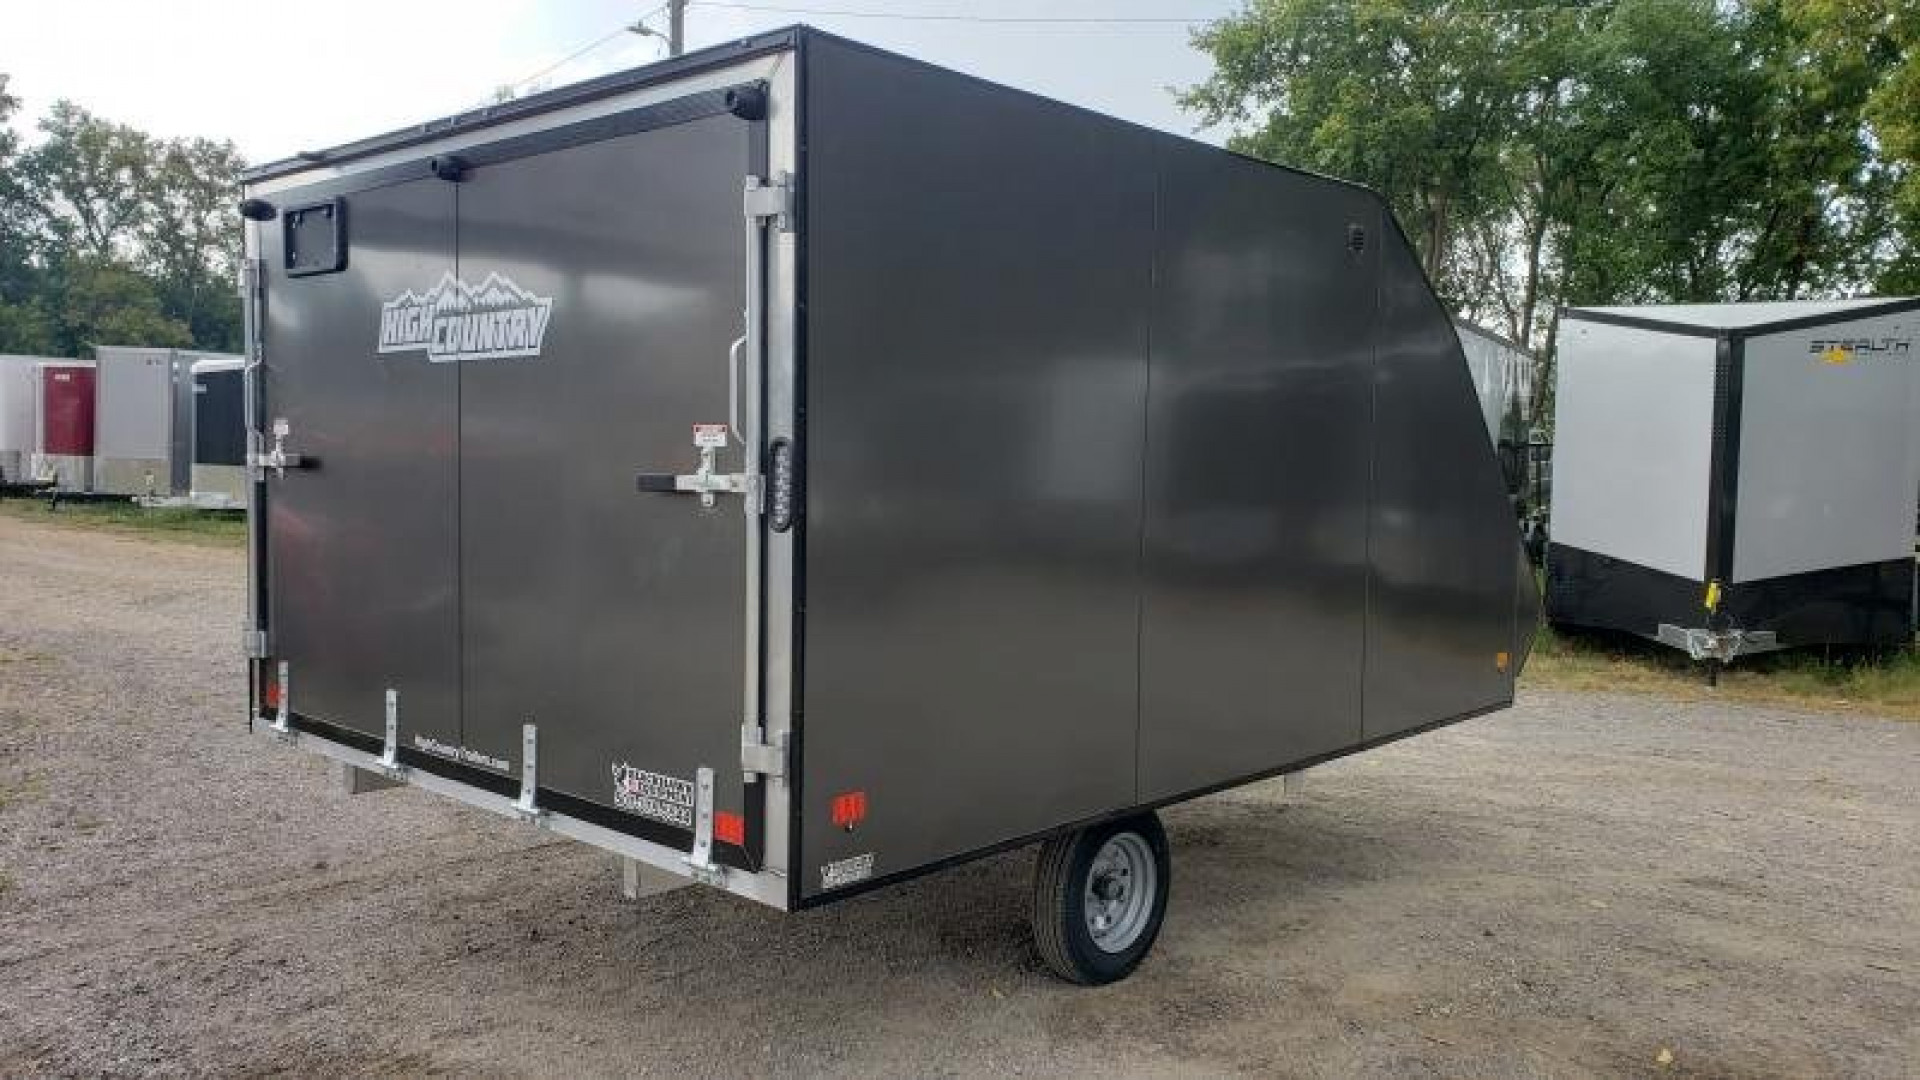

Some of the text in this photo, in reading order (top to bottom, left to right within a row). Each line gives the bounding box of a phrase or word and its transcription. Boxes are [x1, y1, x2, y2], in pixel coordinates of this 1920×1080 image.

[384, 306, 547, 355] HIGH COUNTRY
[1809, 337, 1911, 356] STEALTH
